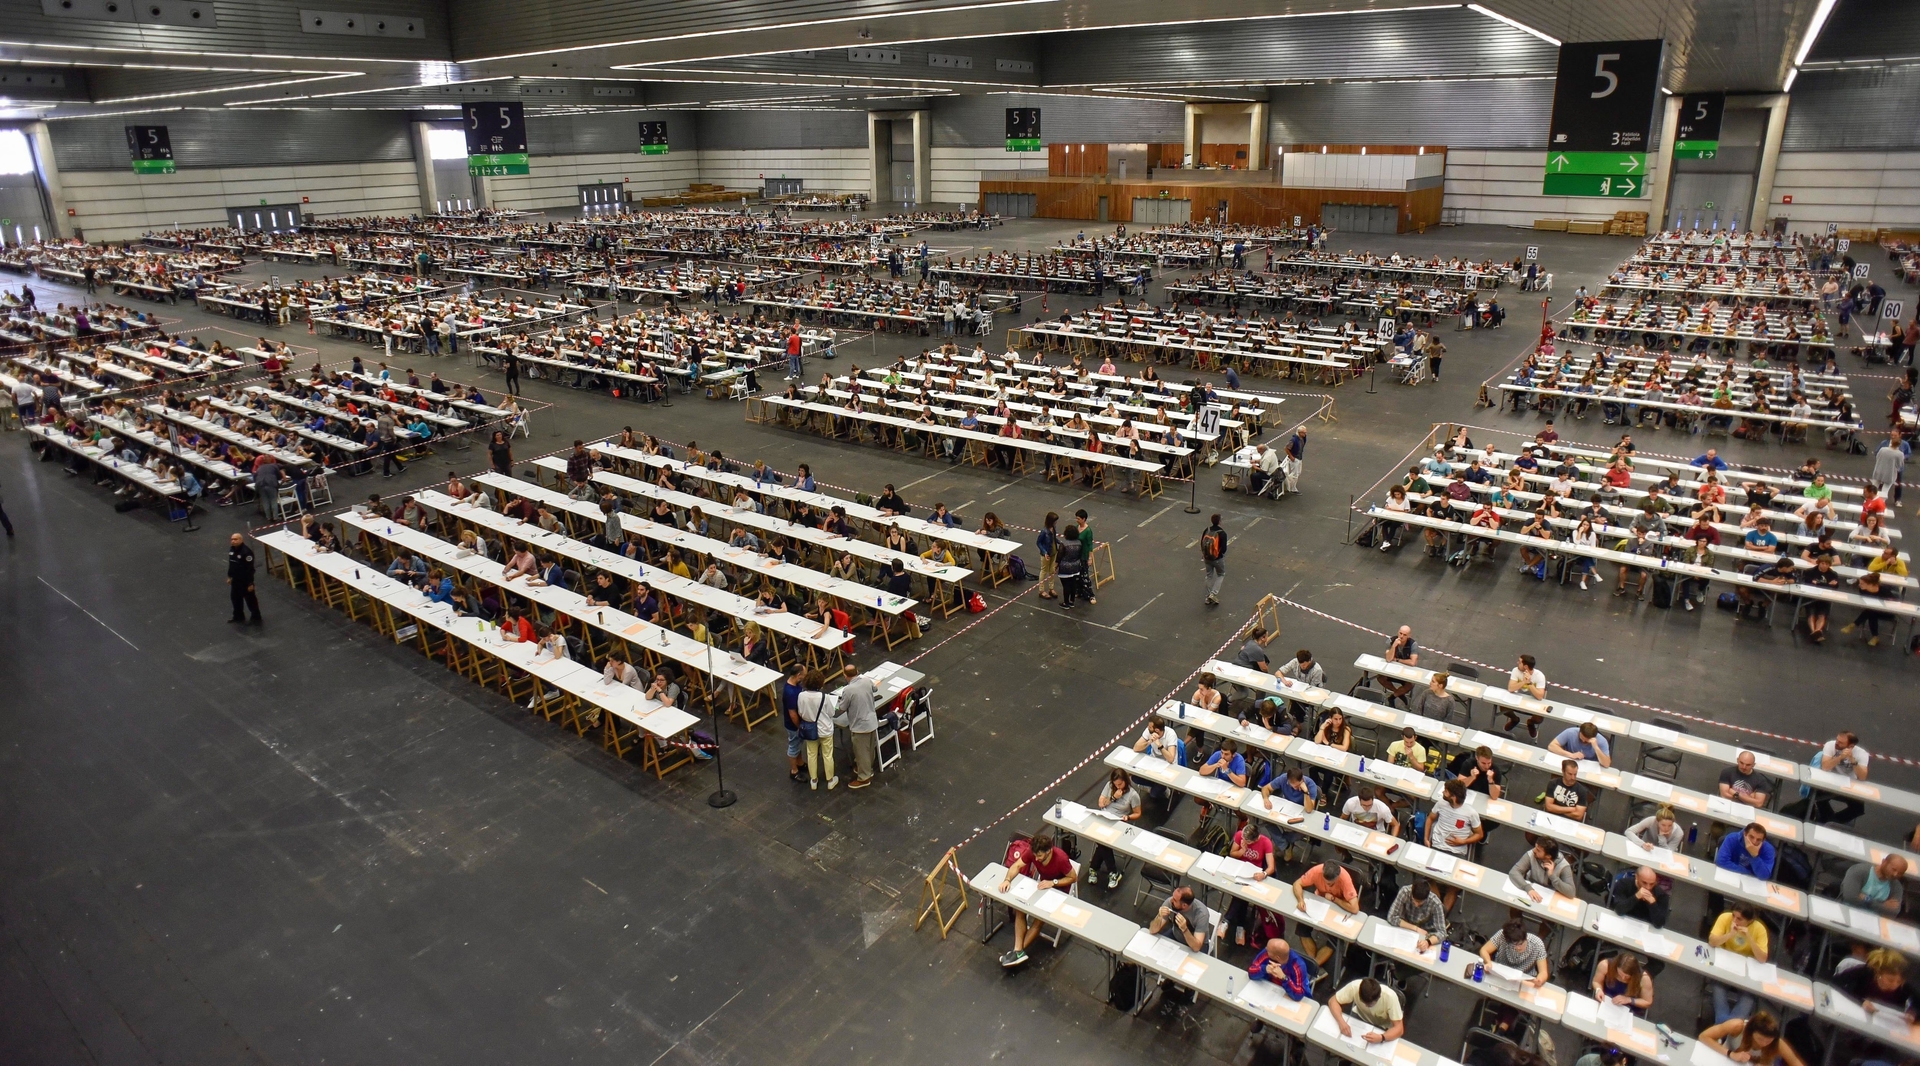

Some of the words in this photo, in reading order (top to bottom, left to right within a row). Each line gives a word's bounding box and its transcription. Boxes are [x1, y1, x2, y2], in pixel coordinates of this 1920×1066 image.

[1591, 53, 1620, 99] 5
[1695, 101, 1708, 120] 5
[470, 108, 478, 129] 5
[500, 107, 511, 129] 5
[1013, 111, 1020, 124] 5
[1031, 111, 1036, 124] 5
[643, 124, 648, 134] 5
[656, 123, 661, 134] 5
[147, 129, 158, 144] 5
[1611, 132, 1620, 146] 3
[1829, 223, 1837, 232] 64
[1215, 231, 1221, 241] 51
[1839, 241, 1849, 251] 63
[1105, 250, 1112, 261] 50
[1528, 248, 1537, 258] 55
[1855, 265, 1868, 277] 62
[1466, 275, 1476, 288] 54
[940, 282, 949, 296] 49
[1884, 302, 1900, 318] 60
[1380, 320, 1393, 337] 48
[665, 333, 673, 350] 45
[1201, 409, 1218, 433] 47
